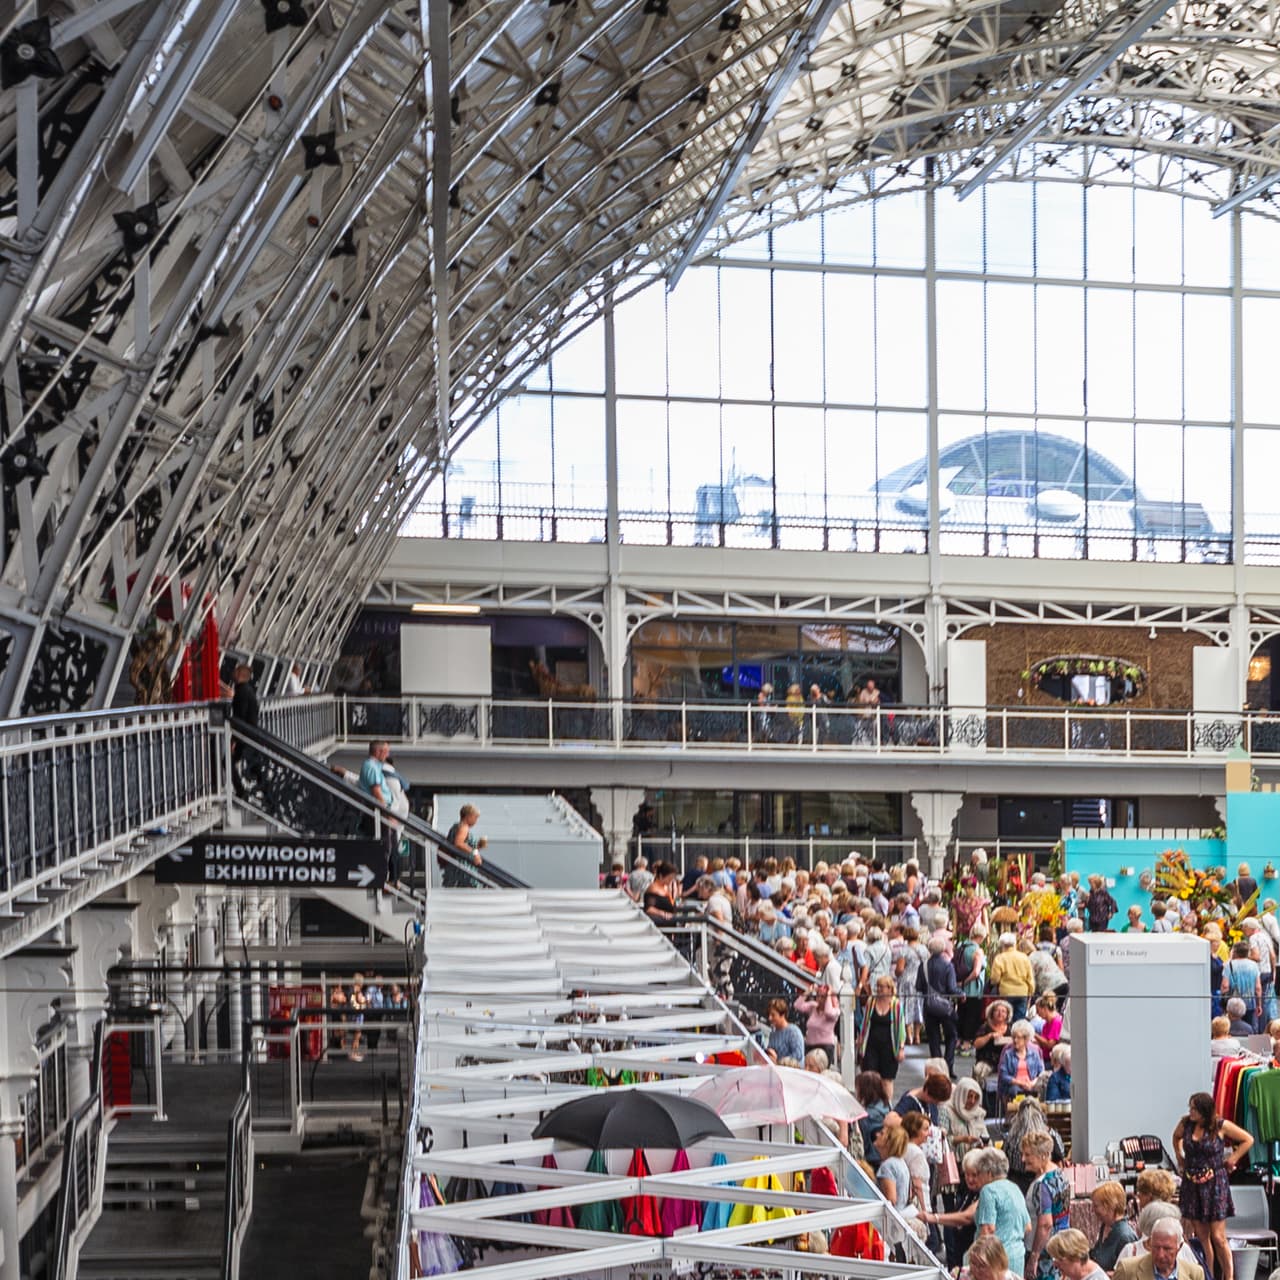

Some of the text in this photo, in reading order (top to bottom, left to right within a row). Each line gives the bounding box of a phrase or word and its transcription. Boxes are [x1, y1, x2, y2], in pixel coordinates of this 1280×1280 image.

[638, 623, 731, 645] CANAL
[205, 843, 336, 863] SHOWROOMS
[205, 864, 336, 882] EXHIBITIONS
